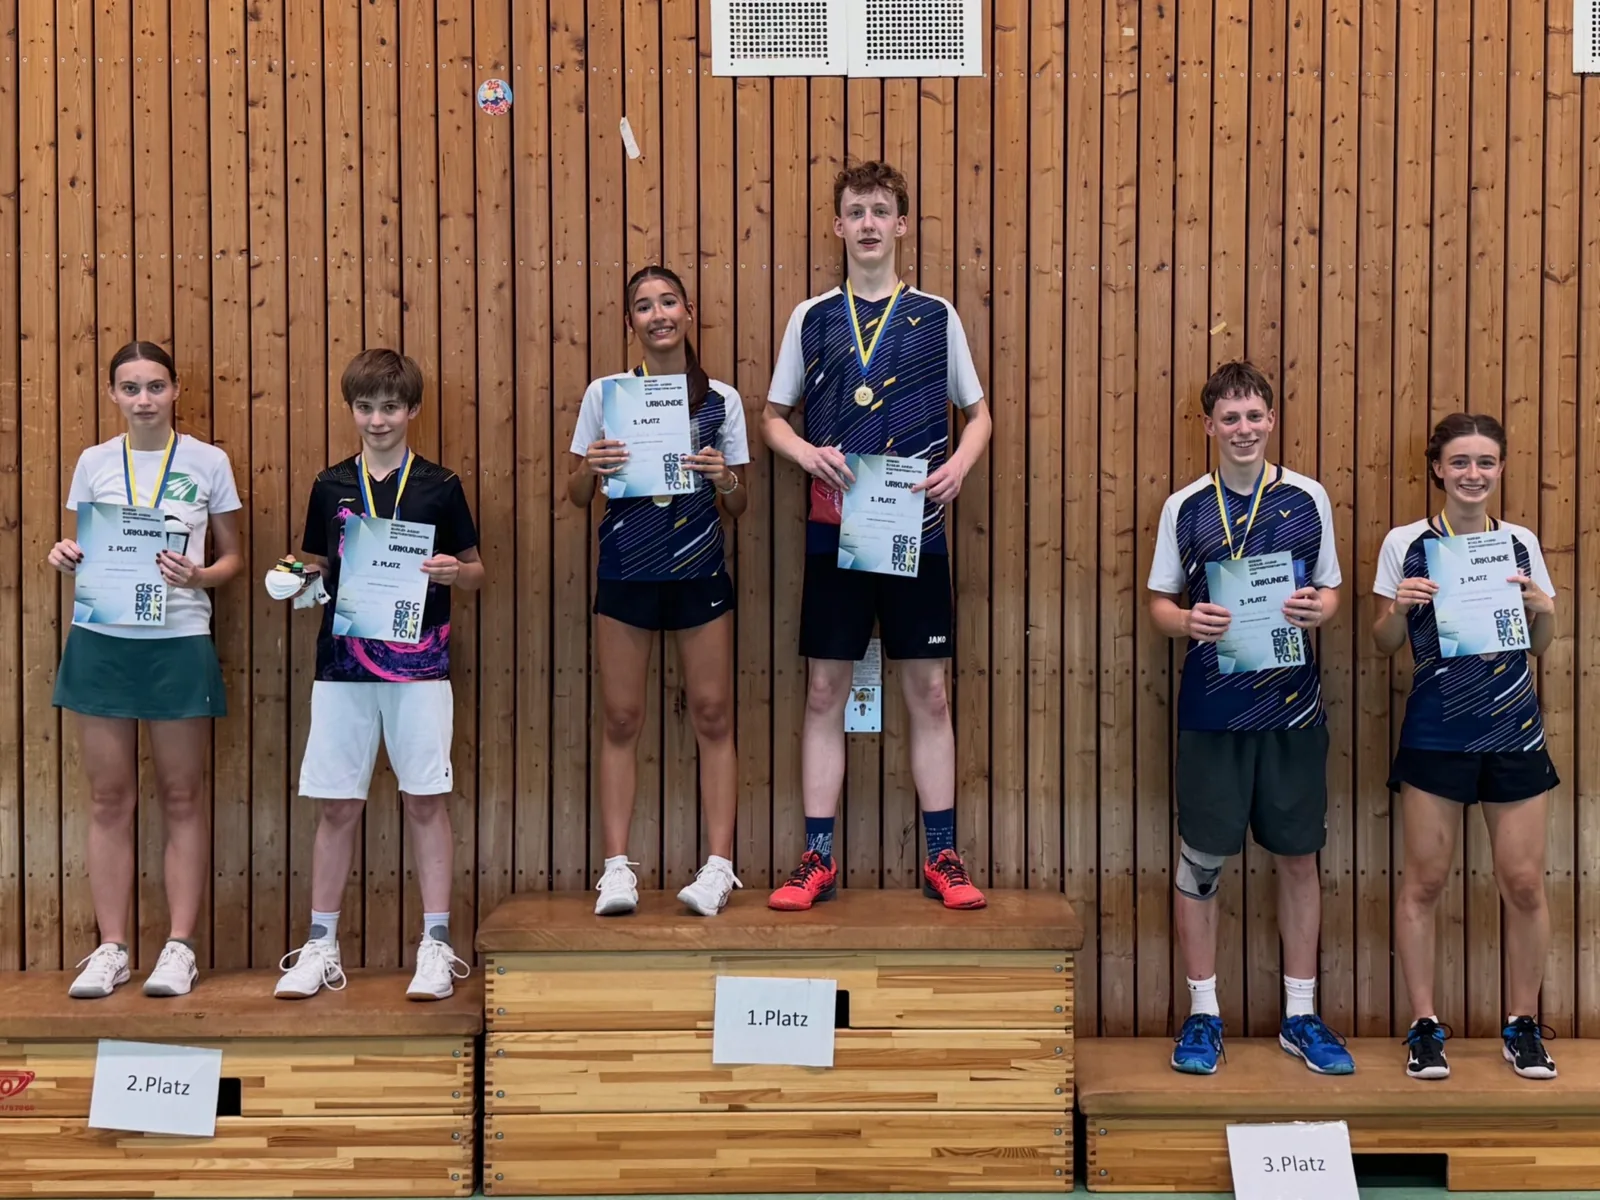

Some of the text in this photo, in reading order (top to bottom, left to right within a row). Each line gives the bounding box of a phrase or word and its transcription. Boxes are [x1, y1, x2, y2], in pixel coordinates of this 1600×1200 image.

[645, 399, 684, 408] URKUNDE
[641, 417, 660, 425] PLATZ
[665, 470, 690, 481] MIN
[665, 480, 691, 491] TON
[122, 528, 162, 538] URKUNDE
[116, 545, 137, 553] PLATZ
[388, 544, 428, 556] URKUNDE
[892, 543, 917, 554] BAD
[892, 552, 916, 564] MIN
[1470, 554, 1510, 565] URKUNDE
[380, 561, 401, 569] PLATZ
[891, 561, 916, 573] TON
[1250, 575, 1290, 587] URKUNDE
[135, 593, 163, 602] BAD
[1247, 596, 1267, 604] PLATZ
[135, 602, 162, 612] MIN
[135, 612, 162, 622] TON
[394, 609, 420, 621] BAD
[392, 619, 418, 630] MIN
[1495, 617, 1522, 628] BAD
[392, 629, 417, 640] TON
[1497, 627, 1524, 638] MIN
[927, 635, 946, 644] JAKO
[1272, 635, 1299, 646] BAD
[1498, 636, 1526, 647] TON
[1273, 644, 1301, 655] MIN
[1275, 654, 1302, 664] TON
[747, 1009, 808, 1027] 1.Platz
[126, 1074, 190, 1096] 2.Platz
[1262, 1155, 1326, 1173] 3.Platz
